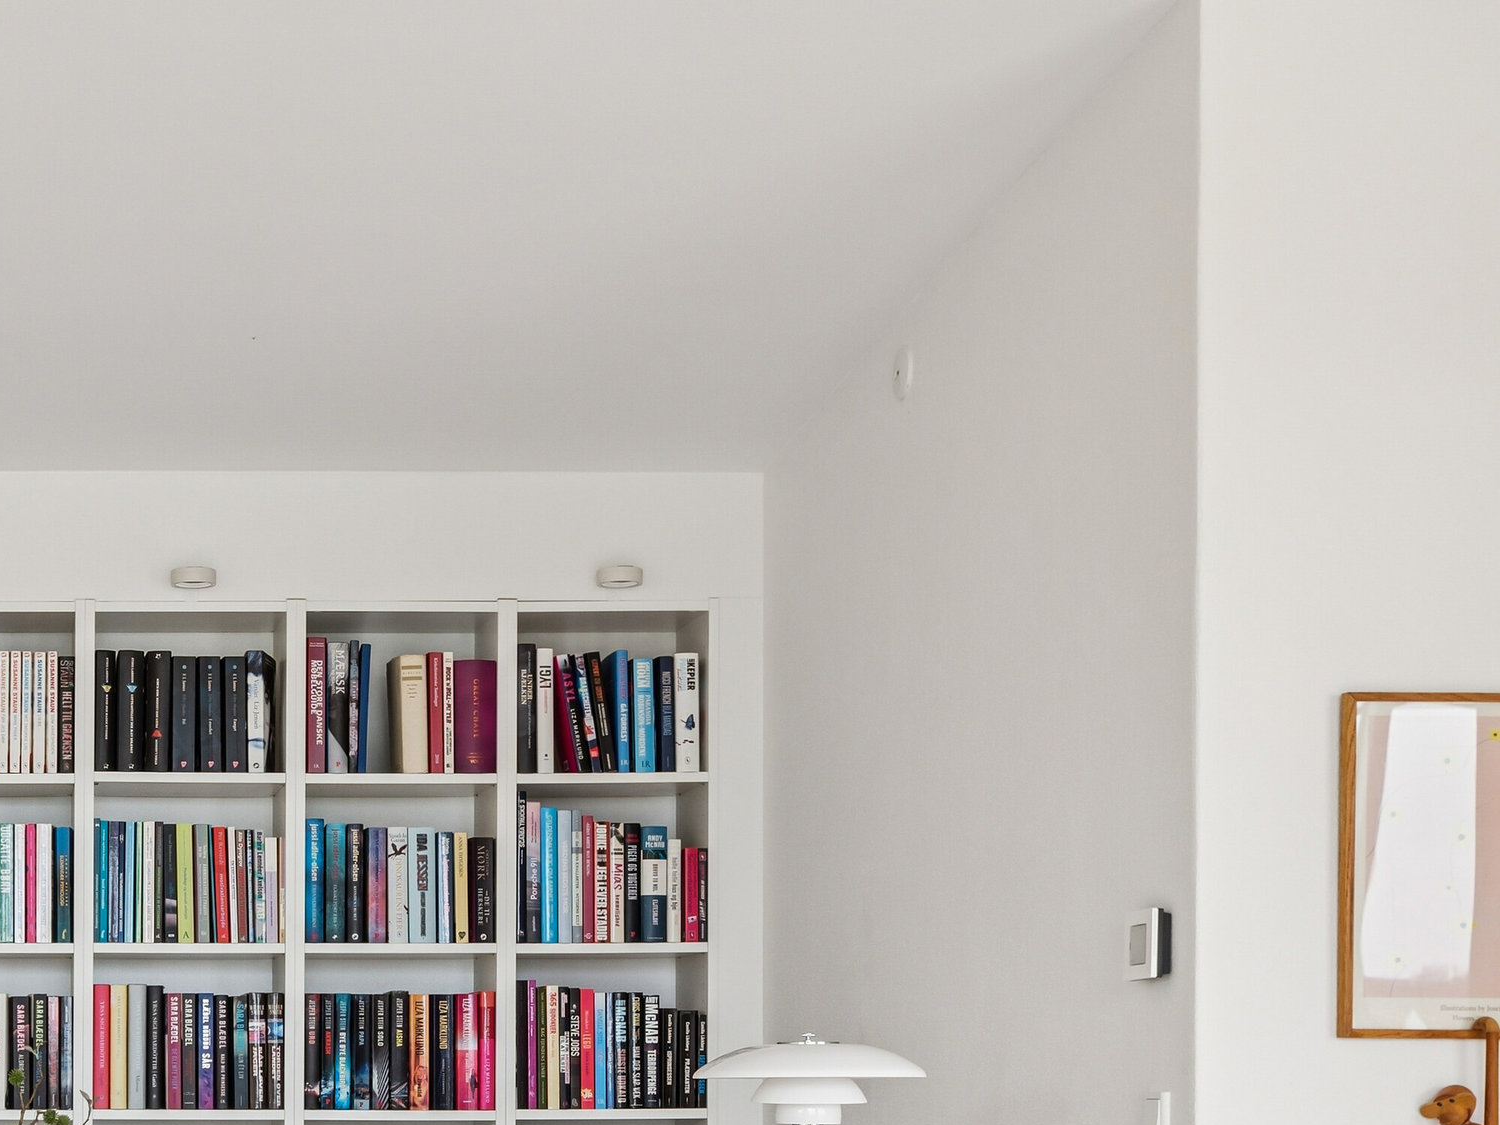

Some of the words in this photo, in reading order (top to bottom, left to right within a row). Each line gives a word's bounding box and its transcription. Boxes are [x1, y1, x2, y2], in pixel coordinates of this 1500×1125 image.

[335, 649, 346, 695] MÆRSK
[686, 662, 696, 691] KEPLER
[62, 691, 73, 709] HELT
[562, 672, 575, 703] ASYL
[62, 711, 73, 722] TIL
[620, 703, 628, 712] GÅ
[620, 713, 628, 743] FORREST
[62, 723, 73, 761] GRÆNSEN
[311, 823, 321, 844] jussi
[311, 844, 321, 882] adler-olsen
[613, 863, 624, 890] Mias
[530, 868, 538, 901] Porsche
[218, 999, 227, 1018] SARA
[414, 1000, 425, 1016] LIZA
[218, 1020, 227, 1049] BLÆDEL
[414, 1017, 425, 1056] MARKLUND
[570, 1015, 580, 1038] STEVE
[645, 1002, 659, 1044] McNAB
[570, 1038, 580, 1057] JOBS
[582, 1033, 592, 1049] LEGO
[201, 1052, 212, 1069] SÅR
